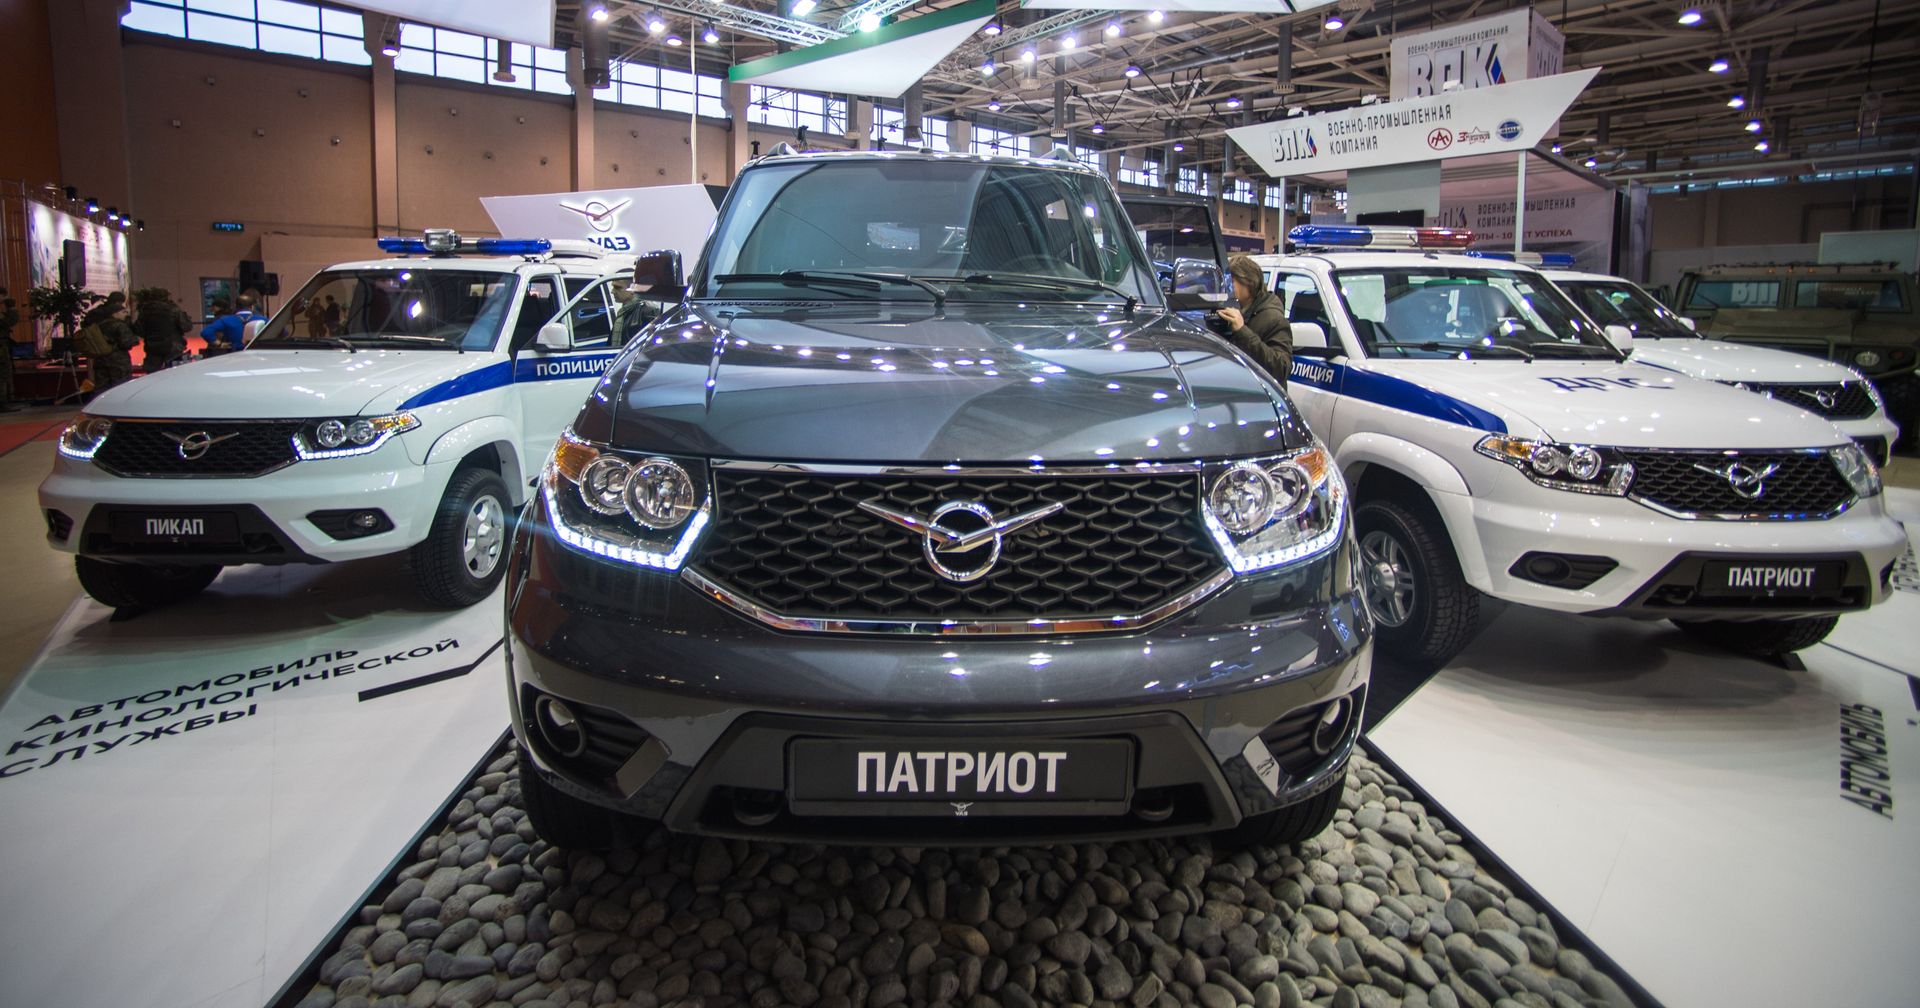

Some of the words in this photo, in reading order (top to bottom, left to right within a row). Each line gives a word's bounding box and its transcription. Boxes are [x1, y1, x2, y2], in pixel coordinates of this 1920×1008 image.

[1408, 33, 1476, 55] ВОЕННО-ПРОМЫШЛЕННАЯ
[1477, 25, 1509, 40] КОМПАНИЯ
[1408, 39, 1503, 97] ВПК
[1328, 104, 1452, 137] ВОЕННО-ПРОМЫШЛЕННАЯ
[1270, 127, 1317, 162] ВПК
[1330, 135, 1379, 155] КОМПАНИЯ
[1478, 198, 1576, 215] ВОЕННО-ПМЫШЛЕННАЯ
[1535, 229, 1573, 238] УСПЕХА
[1290, 361, 1335, 383] ЛИЦИЯ
[146, 519, 204, 535] ПИКАП
[1728, 567, 1815, 587] ПАТРИОТ
[5, 638, 460, 757] КИНОЛОГИЧЕСКОЙ
[24, 649, 359, 731] АВТОМОБИЛЬ
[0, 704, 258, 778] СЛУЖБЫ
[857, 751, 1067, 793] ПАТРИОТ
[1840, 703, 1893, 820] АВТОМОБИЛЬ
